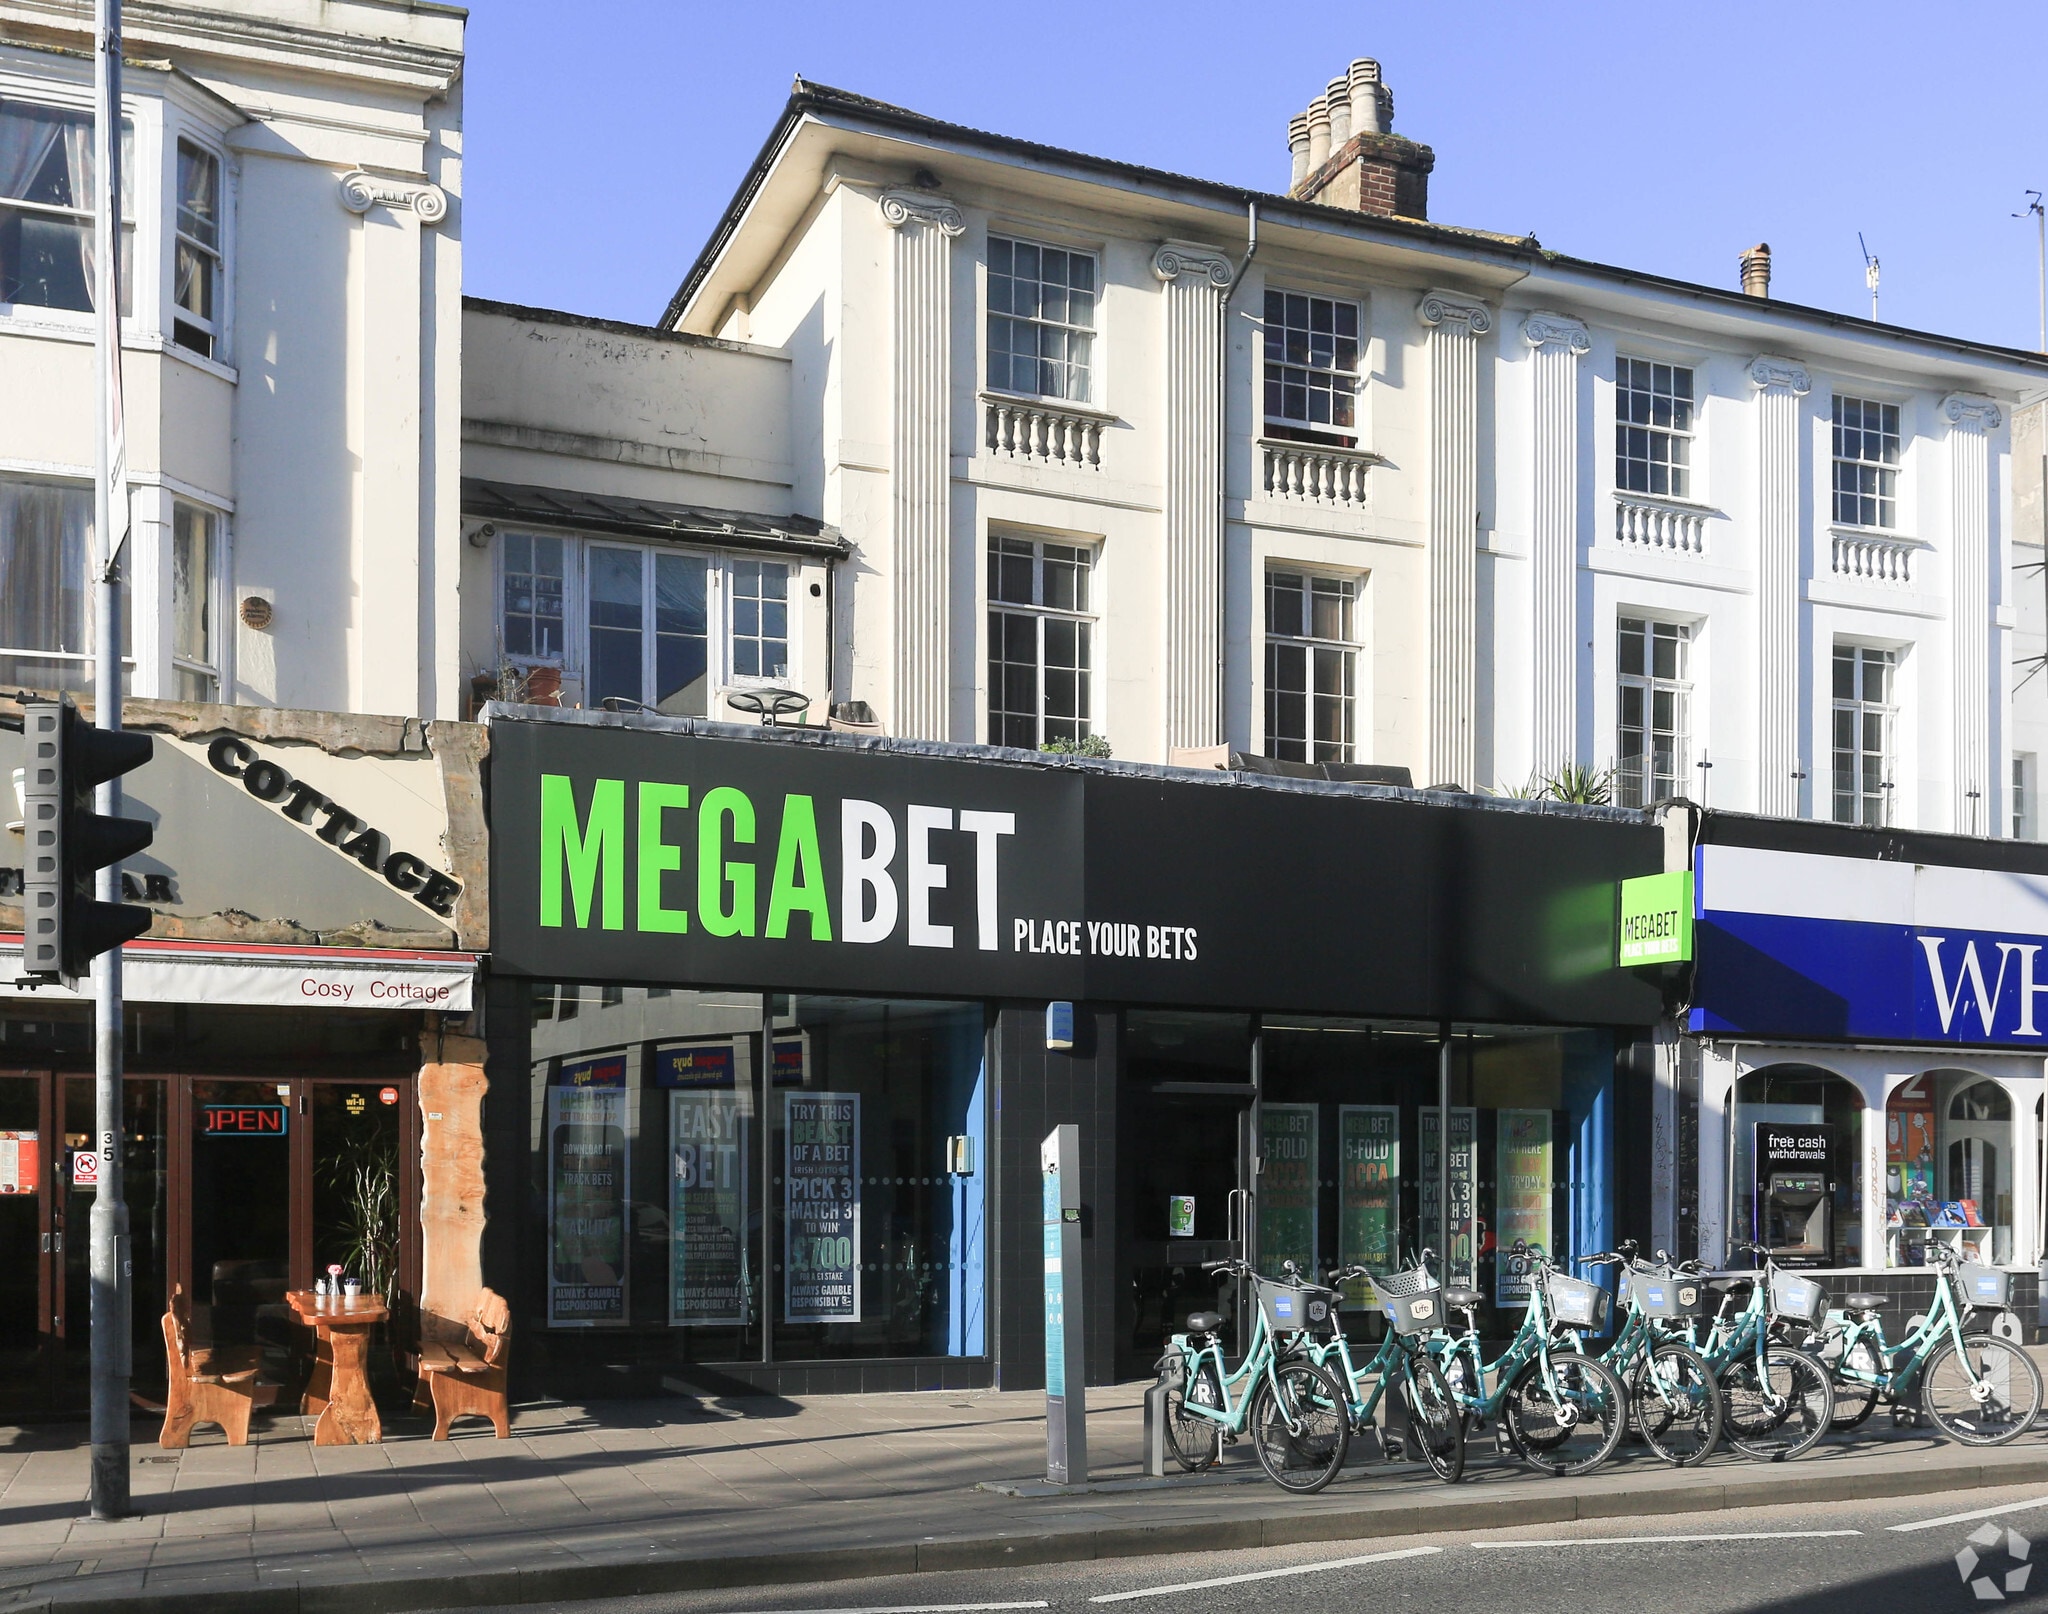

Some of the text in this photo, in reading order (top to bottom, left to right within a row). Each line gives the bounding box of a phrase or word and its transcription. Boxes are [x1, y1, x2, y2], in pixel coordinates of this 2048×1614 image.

[208, 736, 463, 918] COTTAGE
[540, 774, 1016, 951] MEGABET
[1624, 910, 1678, 942] MEGABET
[1014, 919, 1198, 961] PLACE YOUR BETS
[300, 978, 450, 1002] Cosy Cottage
[792, 1104, 852, 1121] TRY THIS
[679, 1104, 737, 1139] EASY
[103, 1132, 113, 1145] 3
[793, 1121, 852, 1144] BEAST
[1768, 1133, 1827, 1149] free cash
[103, 1147, 114, 1161] 5
[793, 1145, 851, 1161] OF A BET
[1263, 1137, 1308, 1159] 5-FOLD
[1346, 1139, 1389, 1160] 5-FOLD
[1768, 1148, 1827, 1160] withdrawals
[679, 1143, 737, 1189] BET
[794, 1166, 814, 1174] IRISH
[563, 1173, 613, 1185] TRACK BETS
[1345, 1162, 1389, 1190] ACCA
[791, 1178, 853, 1199] PICK 3
[1460, 1182, 1471, 1201] 3
[791, 1201, 853, 1219] MATCH 3
[1463, 1202, 1471, 1219] 3
[805, 1222, 817, 1233] TO
[790, 1236, 851, 1271] £700
[825, 1272, 844, 1281] STAKE
[556, 1287, 621, 1298] ALWAYS GAMBLE
[677, 1287, 739, 1299] ALWAYS GAMBLE
[792, 1285, 852, 1296] ALWAYS GAMBLE
[556, 1300, 608, 1311] RESPONSIBLY
[676, 1299, 727, 1310] RESPONSIBLY
[792, 1296, 841, 1307] RESPONSIBLY
